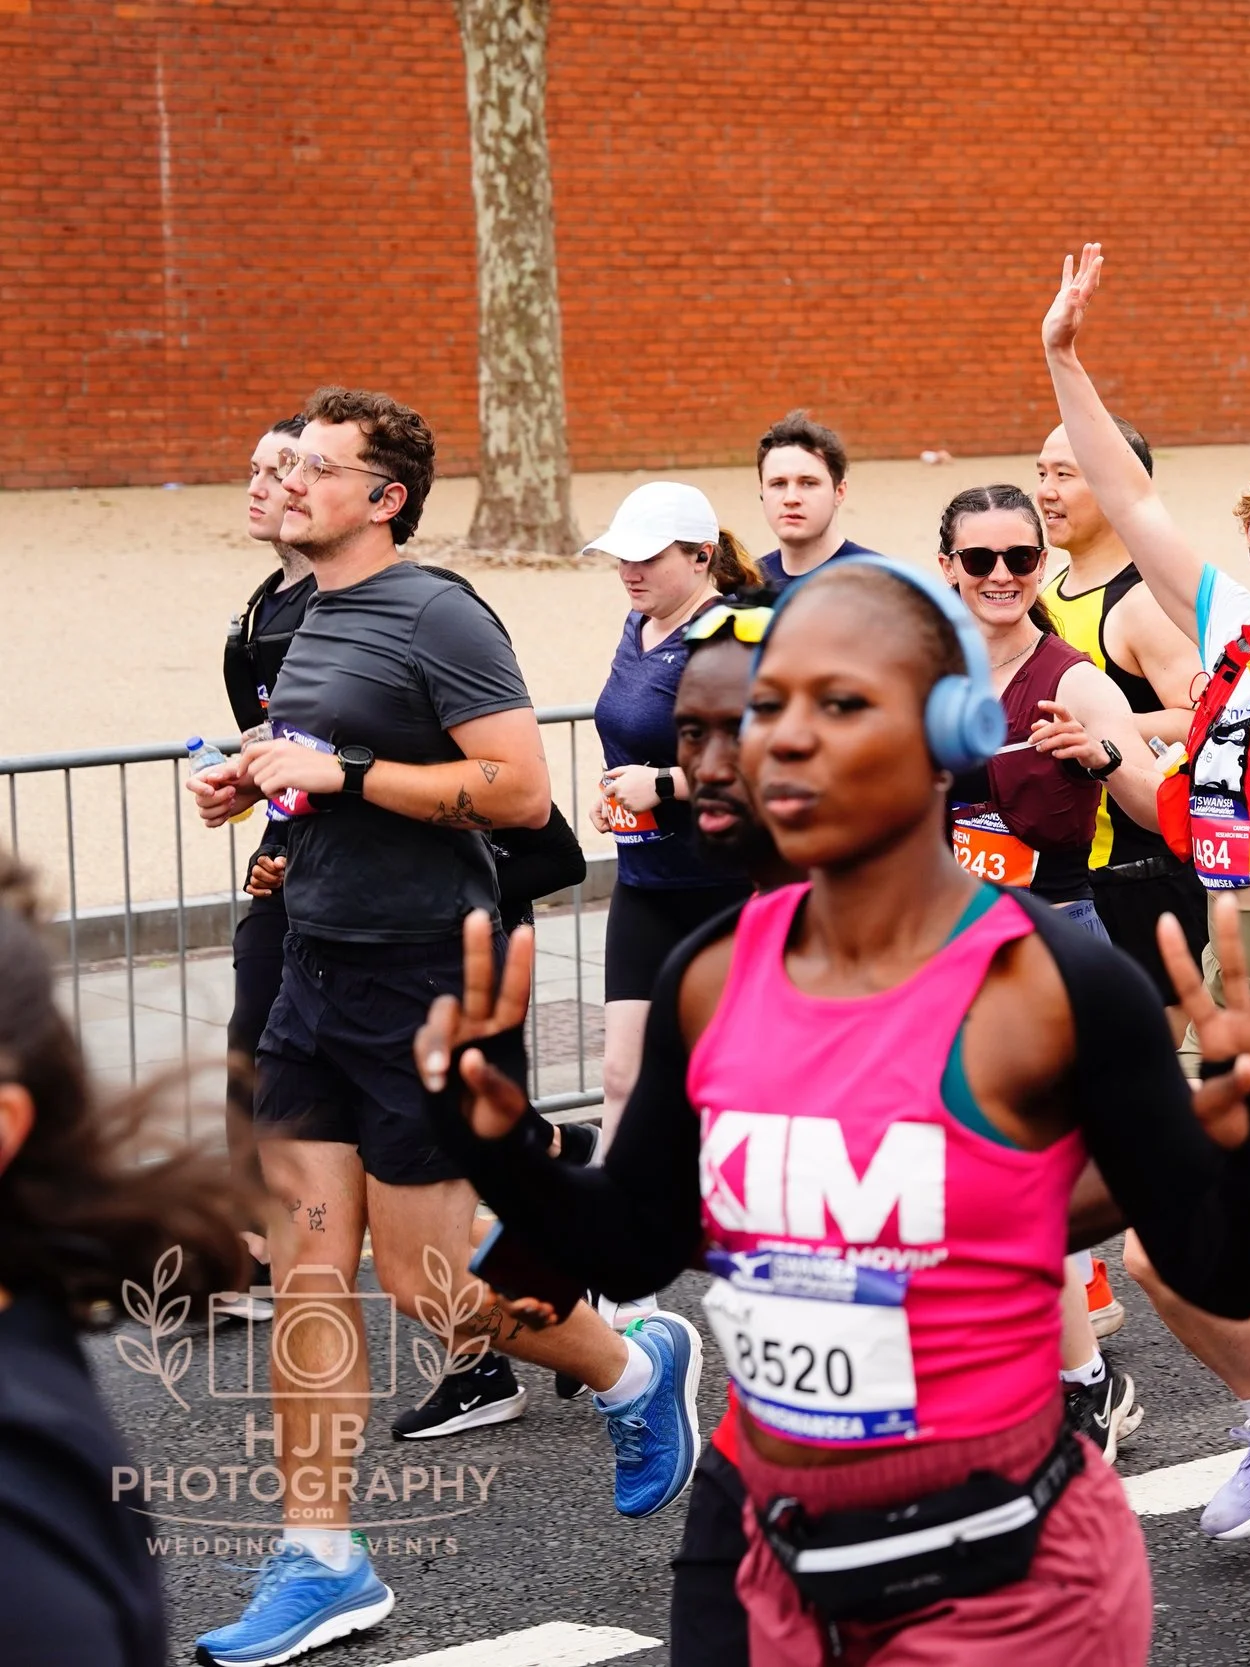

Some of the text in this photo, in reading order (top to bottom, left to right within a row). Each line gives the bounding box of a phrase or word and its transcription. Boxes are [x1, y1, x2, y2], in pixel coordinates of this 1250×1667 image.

[1197, 796, 1235, 808] SWANSEA
[699, 1108, 947, 1244] KIM
[736, 1332, 854, 1398] 8520
